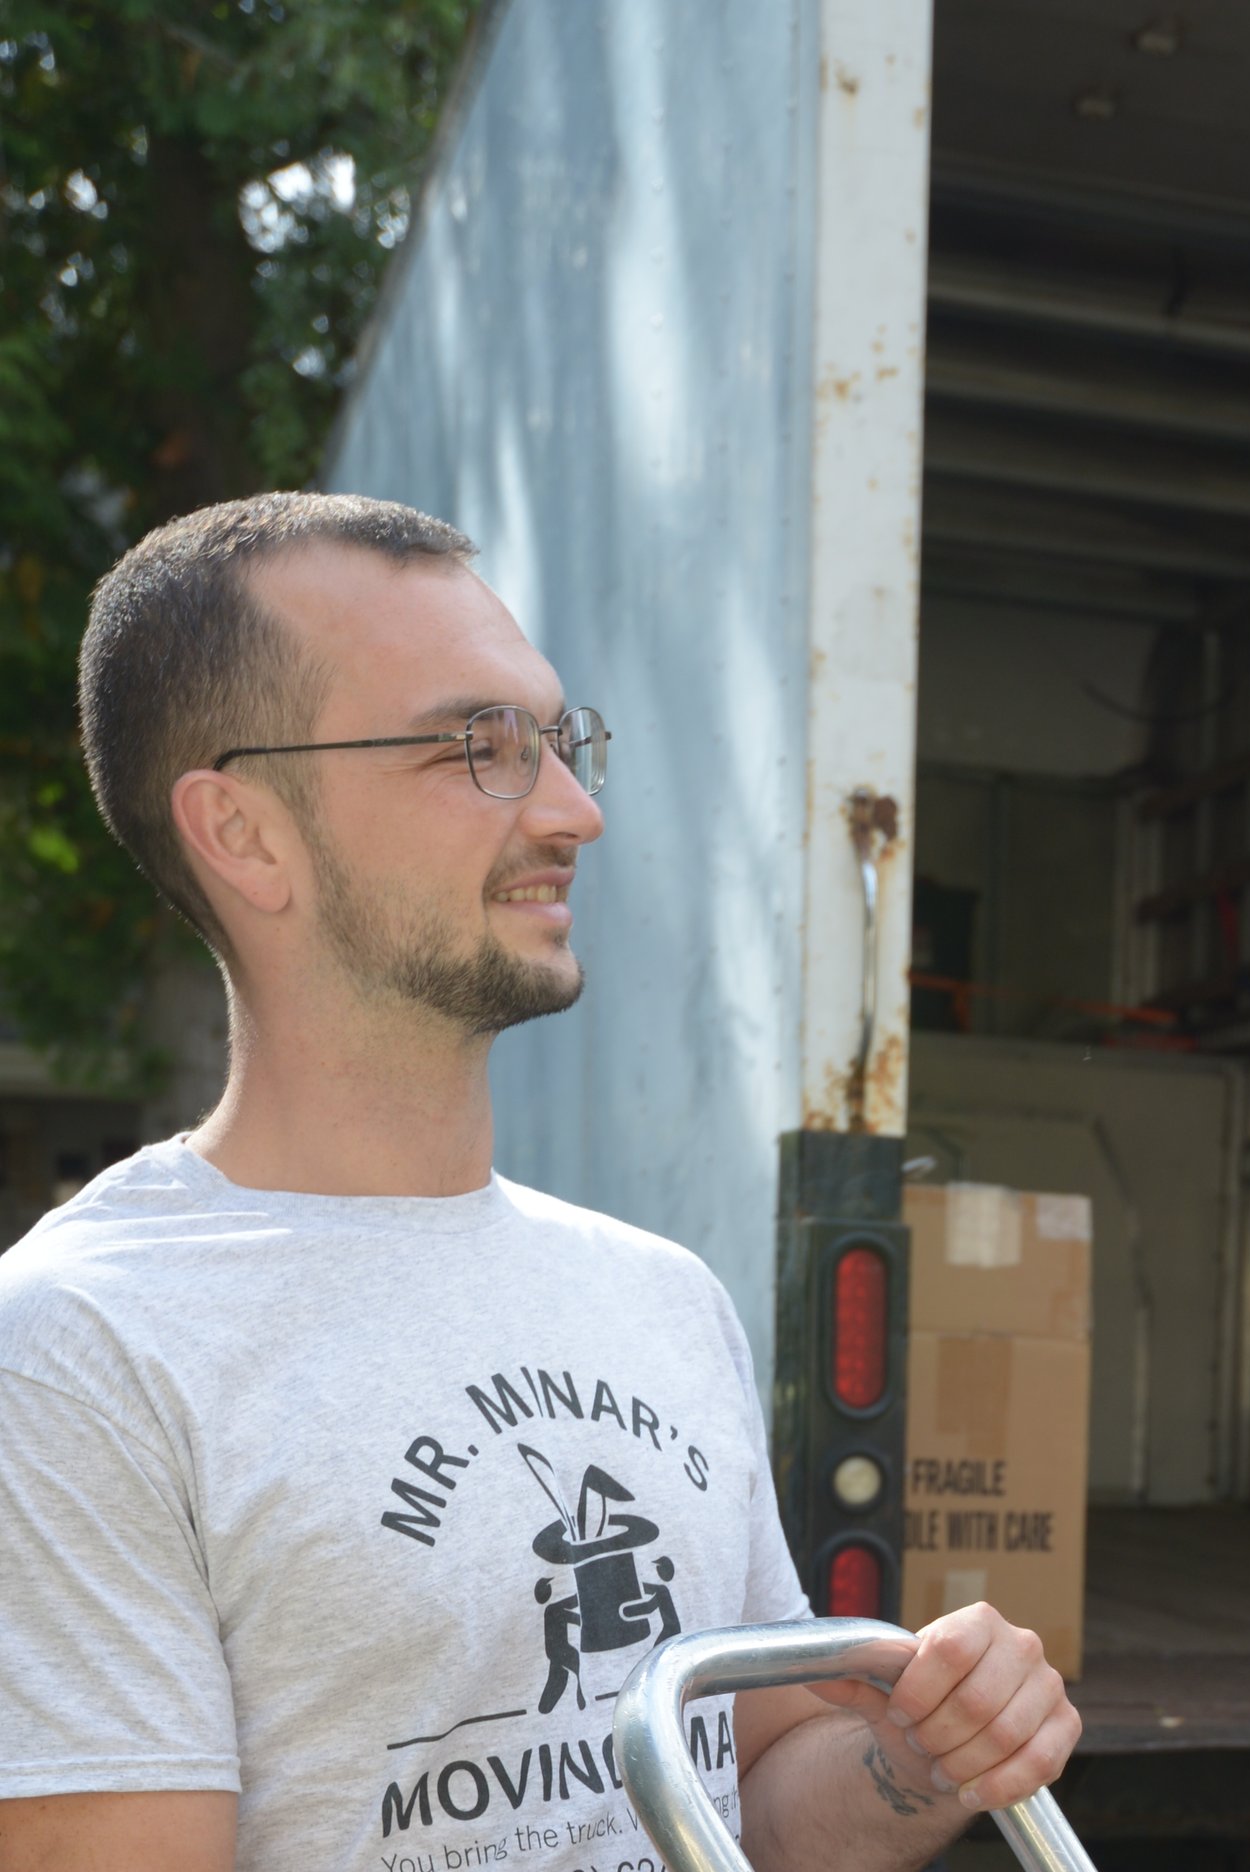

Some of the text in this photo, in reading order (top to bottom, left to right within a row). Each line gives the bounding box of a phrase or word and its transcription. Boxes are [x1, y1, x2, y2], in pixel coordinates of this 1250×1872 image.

[381, 1367, 709, 1548] MR. MINAR'S
[912, 1458, 1007, 1496] FRAGILE
[1005, 1512, 1054, 1551] CARE
[444, 1837, 508, 1871] bring
[514, 1825, 560, 1853] the
[569, 1810, 624, 1845] truck.
